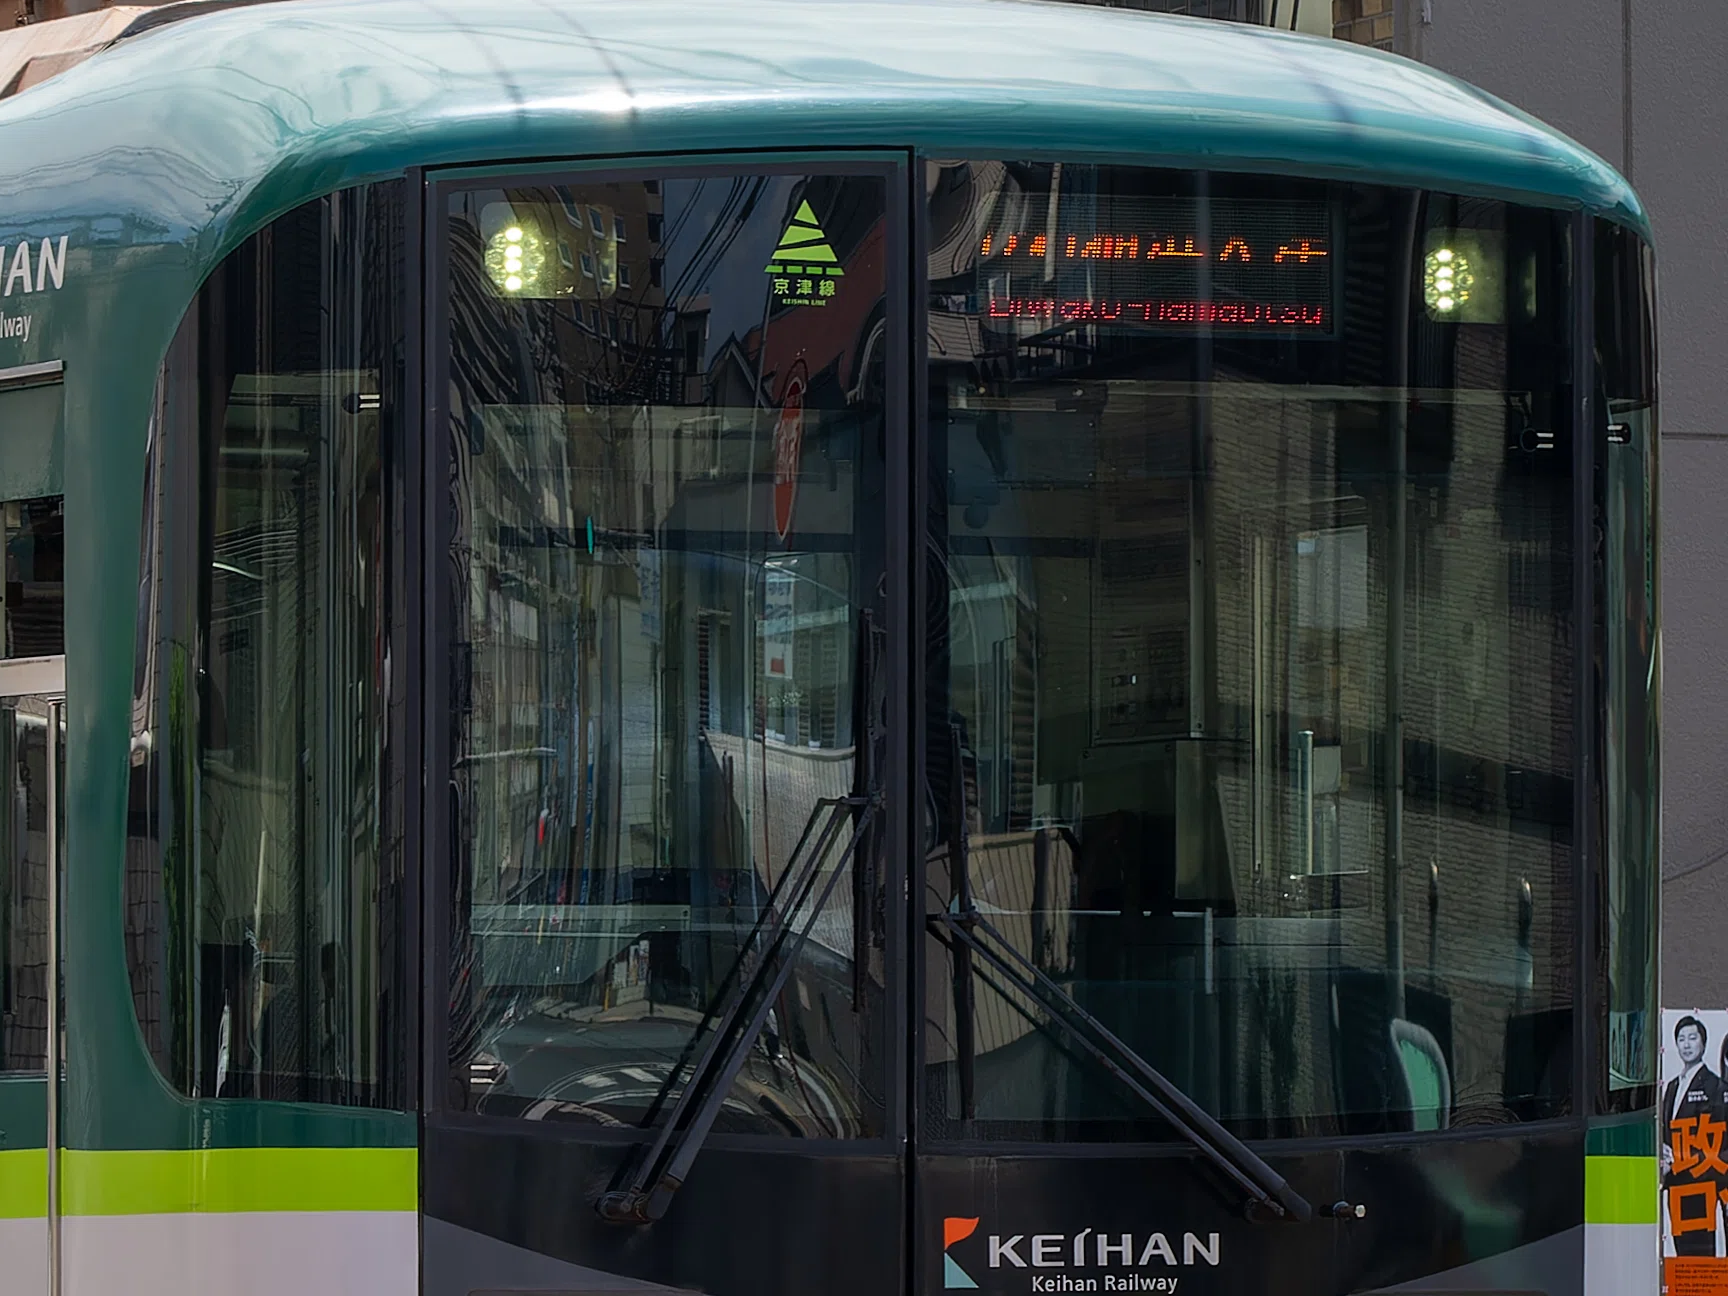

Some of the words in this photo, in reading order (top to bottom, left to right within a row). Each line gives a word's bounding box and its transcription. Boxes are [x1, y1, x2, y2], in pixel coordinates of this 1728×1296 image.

[773, 278, 836, 297] 京津線
[988, 1227, 1221, 1268] KEIHAN
[1032, 1275, 1097, 1293] Keihan
[1104, 1274, 1178, 1295] Railway
